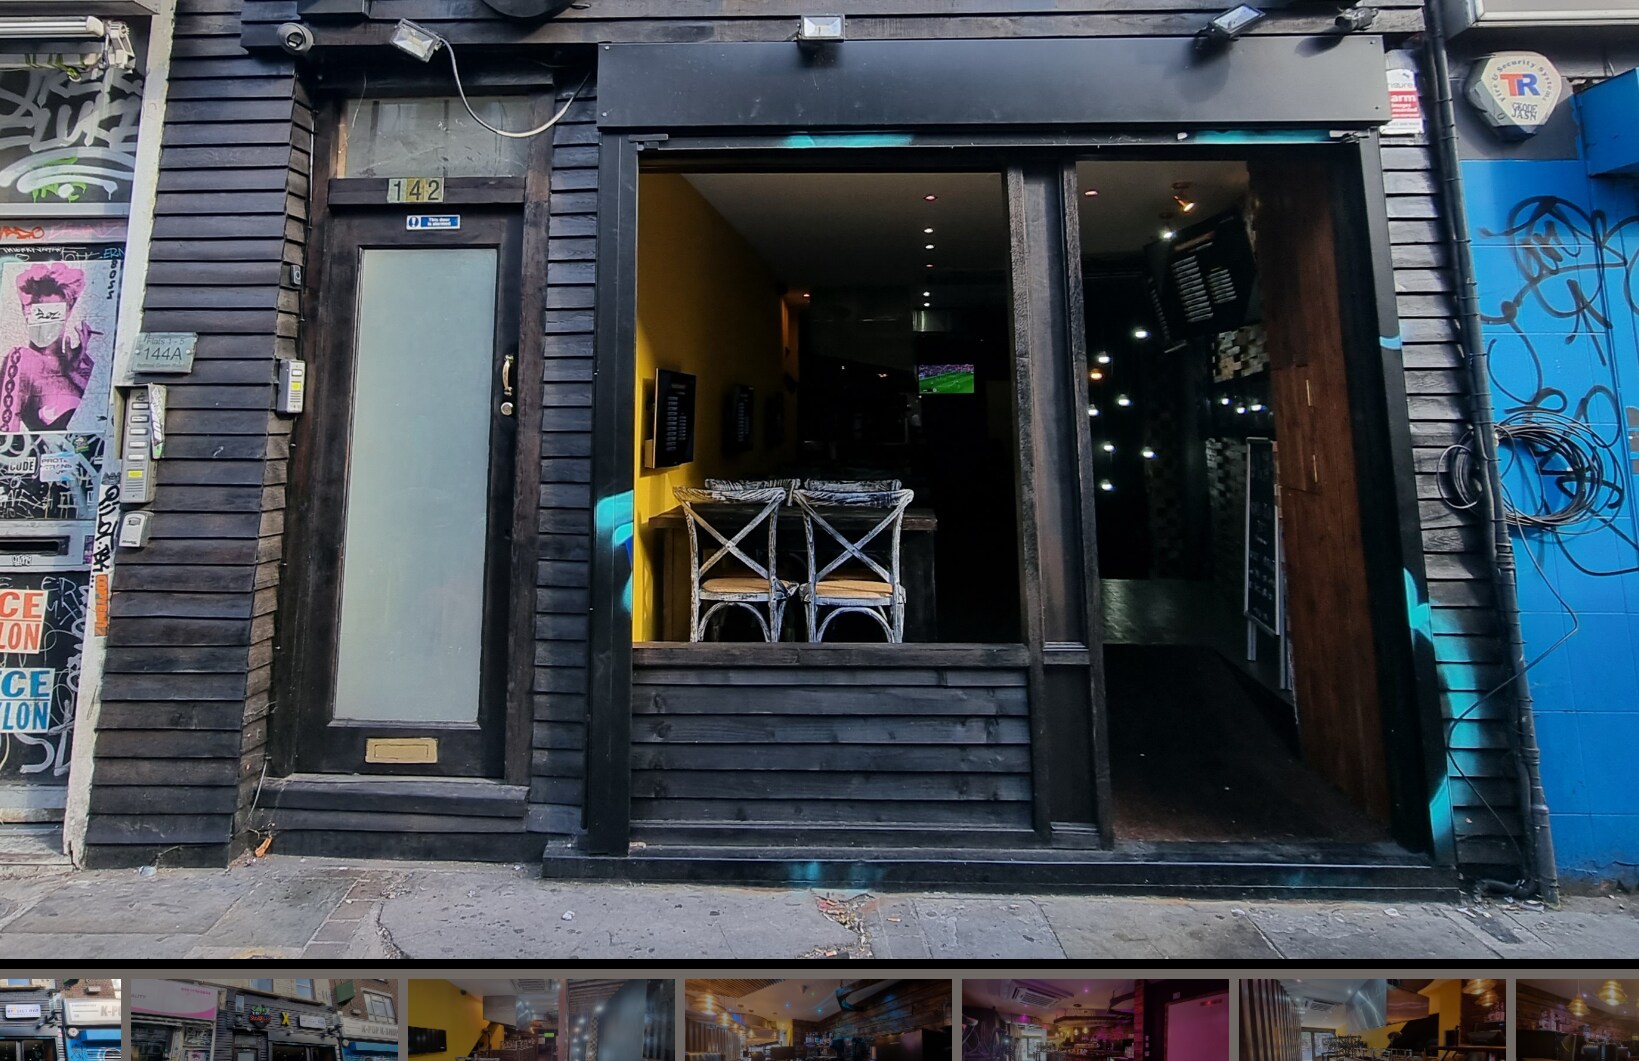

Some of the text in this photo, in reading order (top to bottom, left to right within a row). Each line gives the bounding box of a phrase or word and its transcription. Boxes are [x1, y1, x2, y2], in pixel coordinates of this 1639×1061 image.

[1496, 59, 1536, 72] Security
[1500, 73, 1541, 97] TR
[393, 180, 440, 201] 142
[143, 347, 182, 361] 144A
